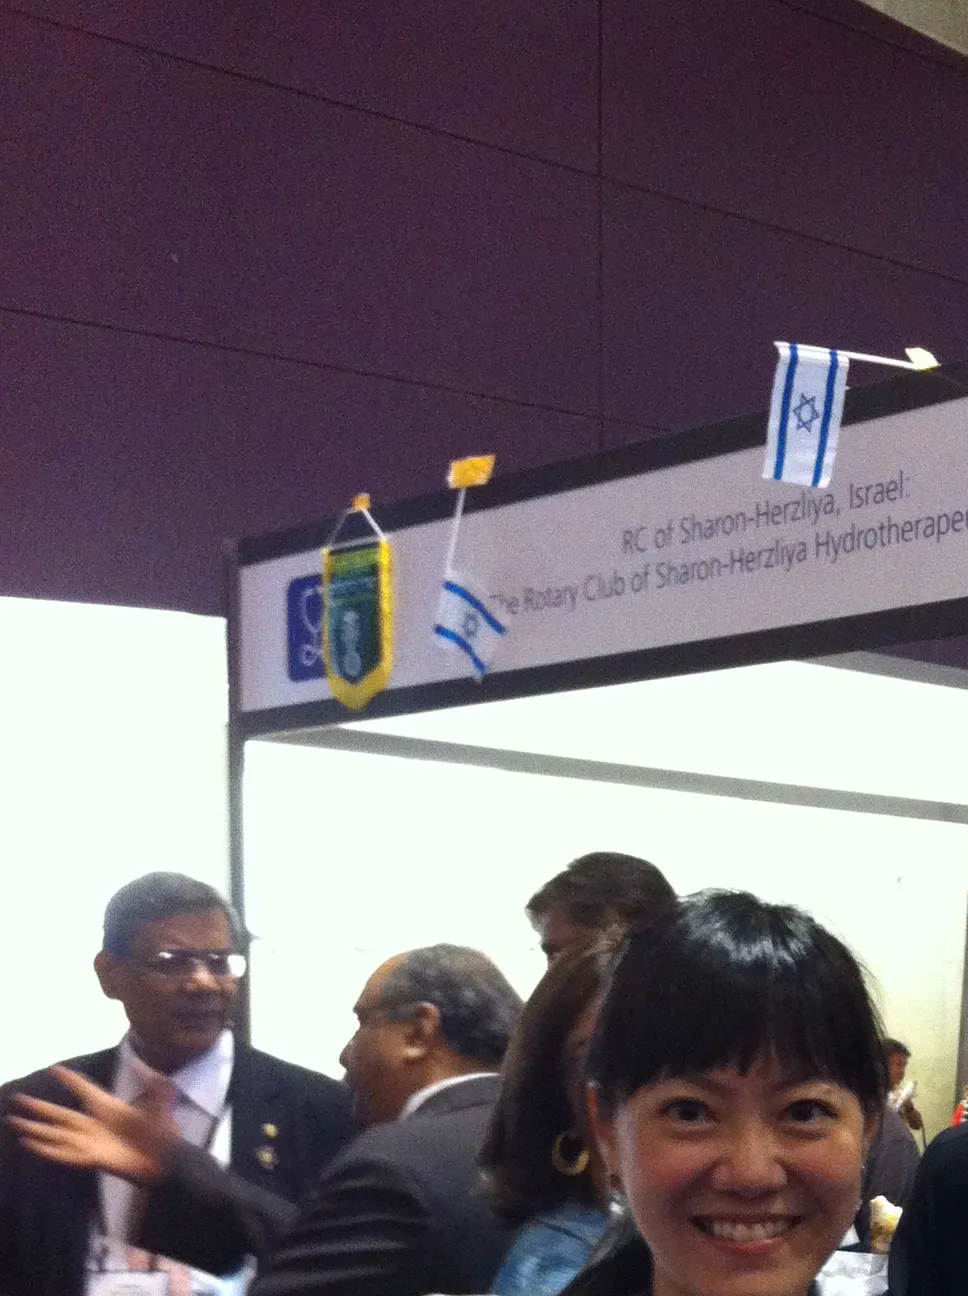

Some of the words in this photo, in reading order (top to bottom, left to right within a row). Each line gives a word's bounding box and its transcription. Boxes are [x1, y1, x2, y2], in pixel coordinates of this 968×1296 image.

[622, 525, 649, 553] RC
[655, 518, 675, 549] of
[680, 489, 842, 545] Sharon-Herzliya,
[523, 584, 579, 613] Rotary
[583, 570, 626, 601] Club
[631, 563, 650, 593] of
[655, 539, 808, 590] Sharon-Herzliya
